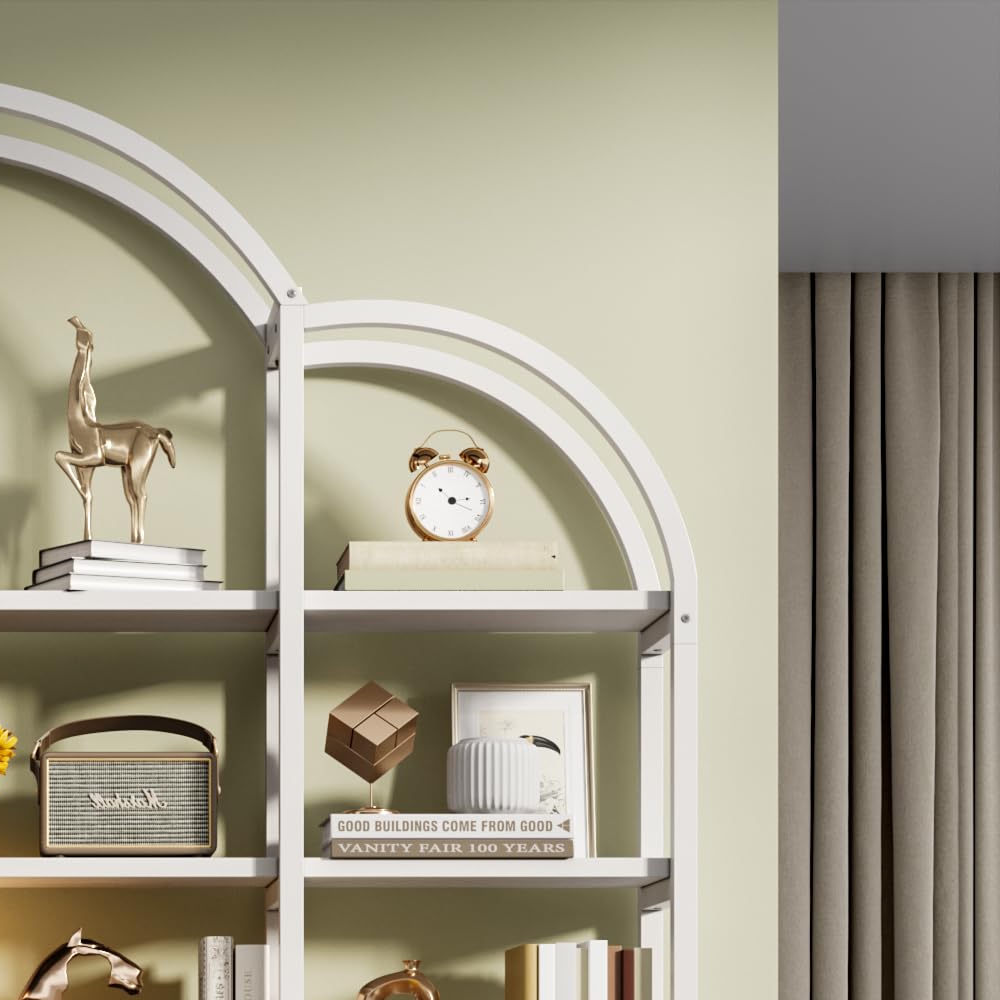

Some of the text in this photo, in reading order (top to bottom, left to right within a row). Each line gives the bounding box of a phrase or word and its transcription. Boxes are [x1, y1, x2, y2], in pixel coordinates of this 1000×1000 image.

[337, 819, 553, 832] GOOD BUILDINGS COME FROM GOOD
[338, 842, 565, 854] VANITY FAIR 100 YEARS
